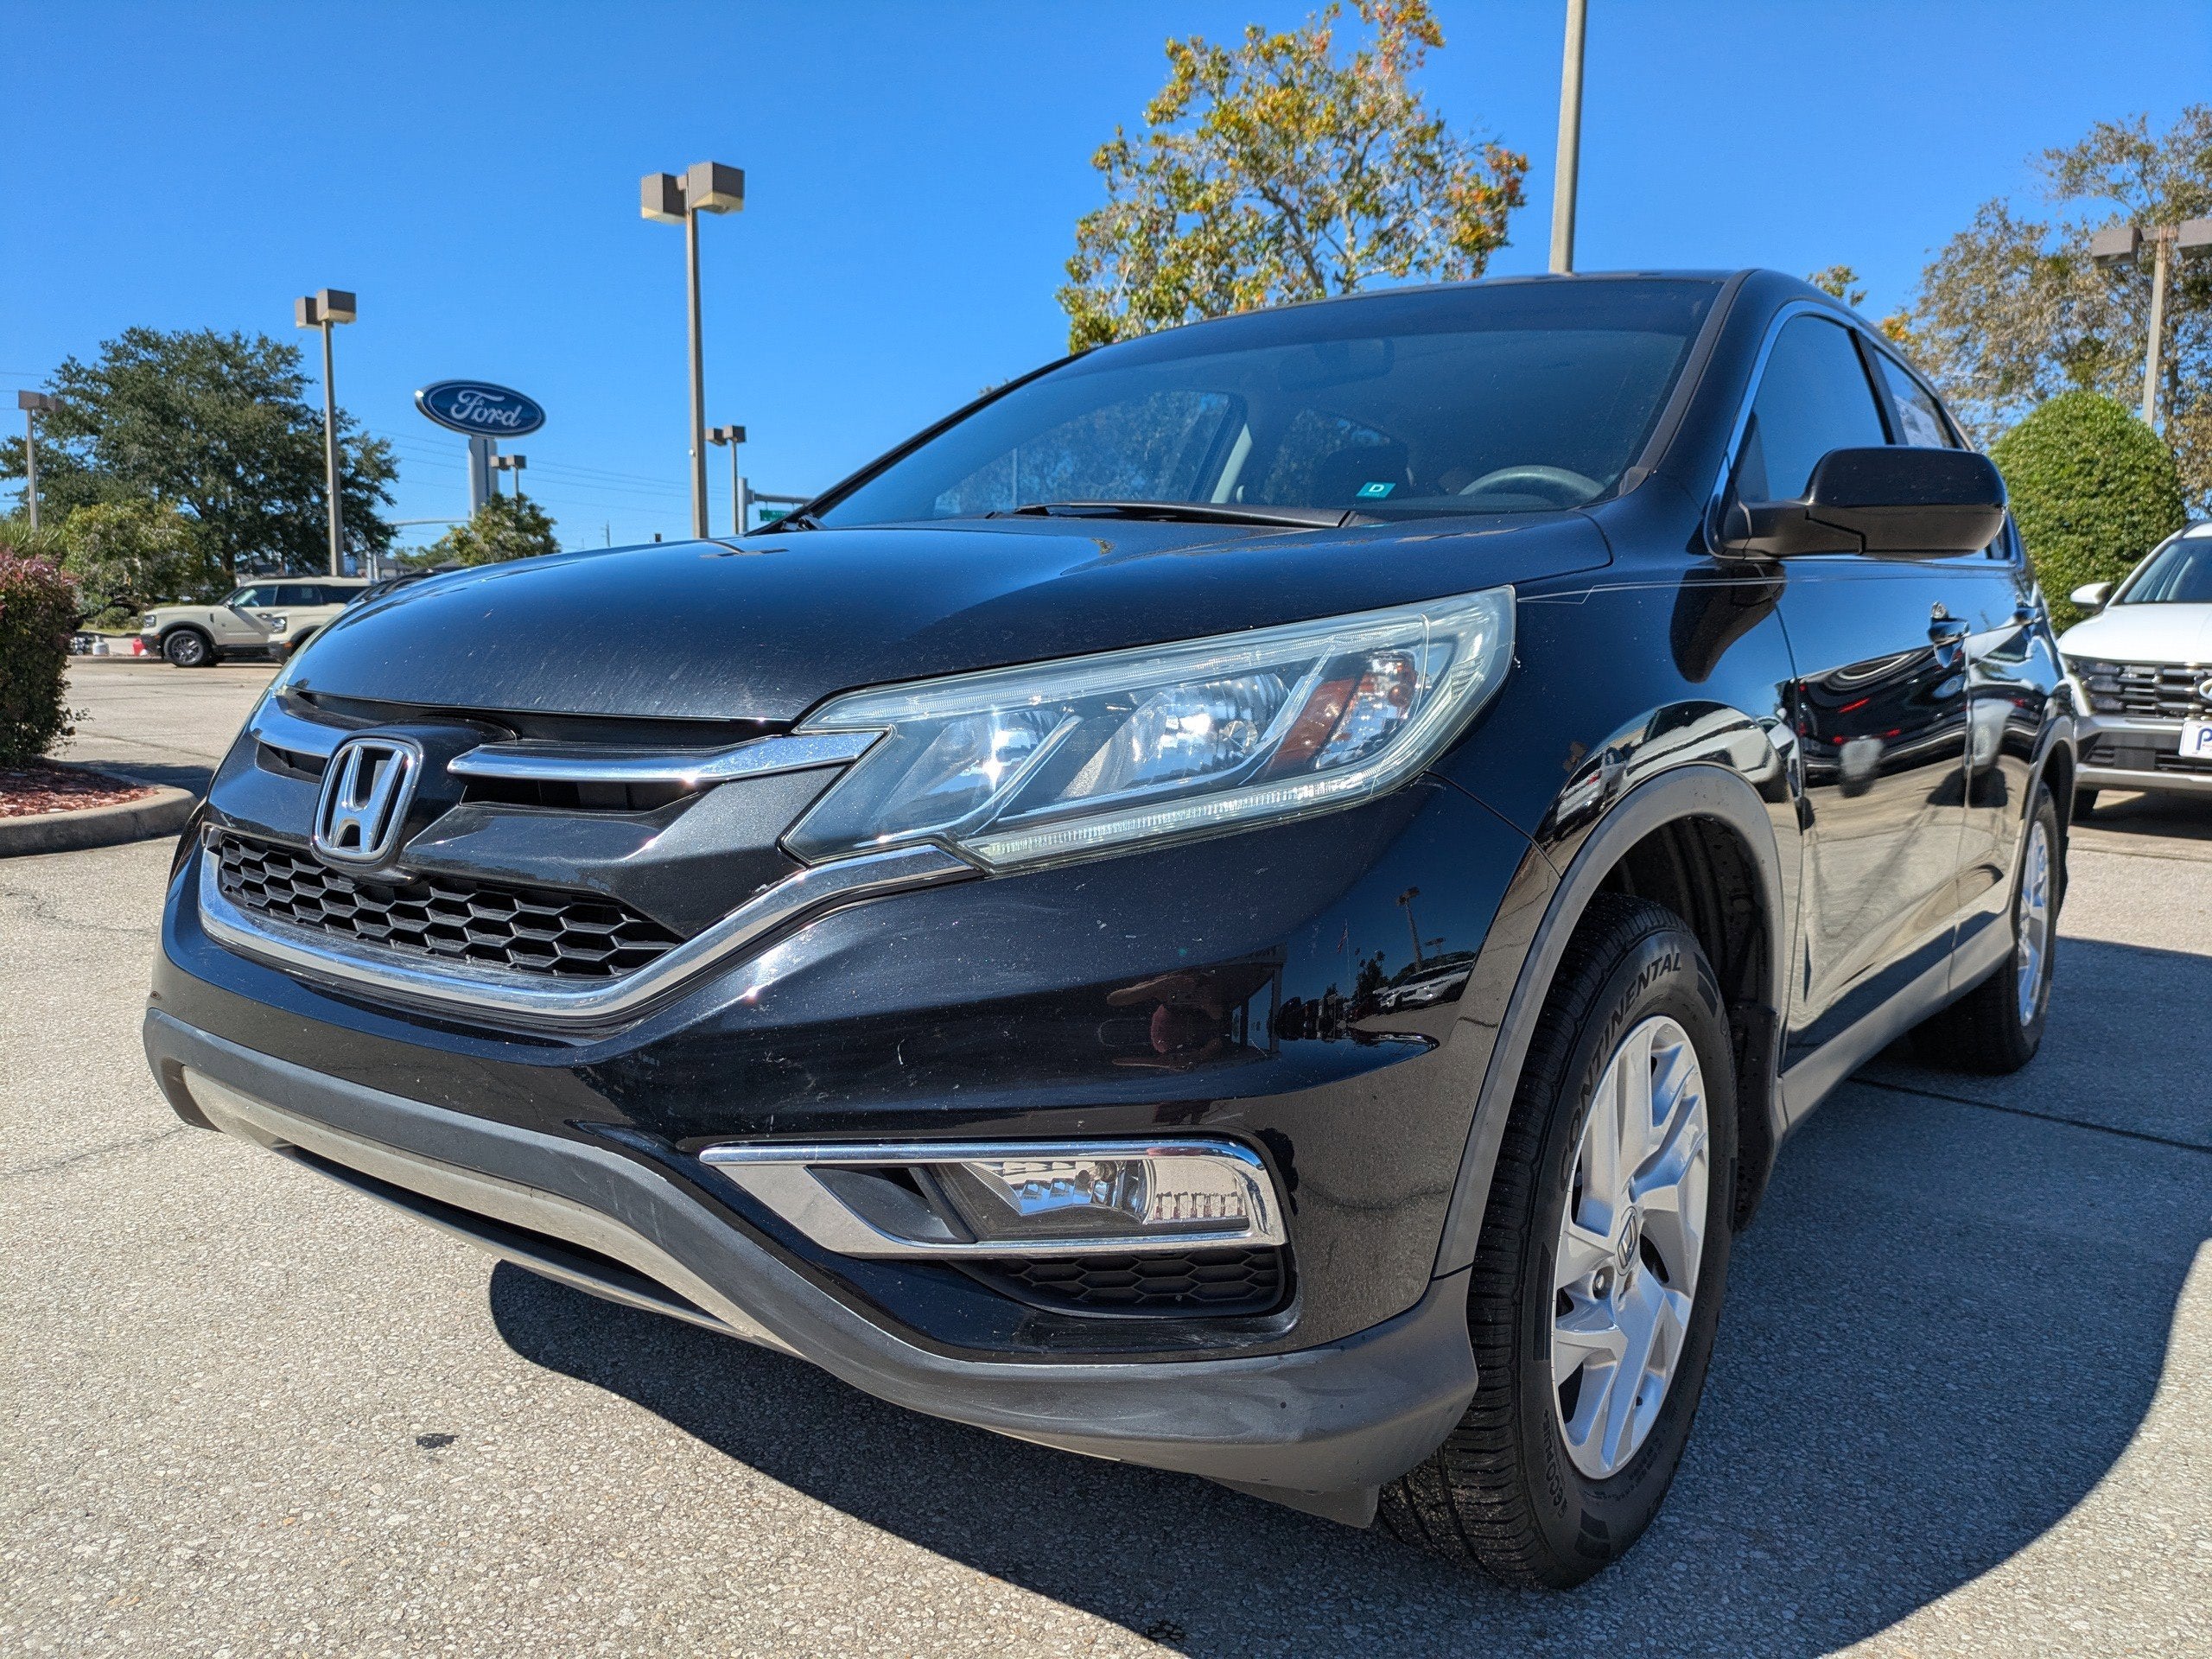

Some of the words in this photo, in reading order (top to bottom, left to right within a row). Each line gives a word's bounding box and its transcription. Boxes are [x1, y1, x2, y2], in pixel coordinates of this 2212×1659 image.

[451, 390, 523, 427] Ford
[1369, 484, 1385, 493] D
[1560, 953, 1681, 1187] CONTINENTAL
